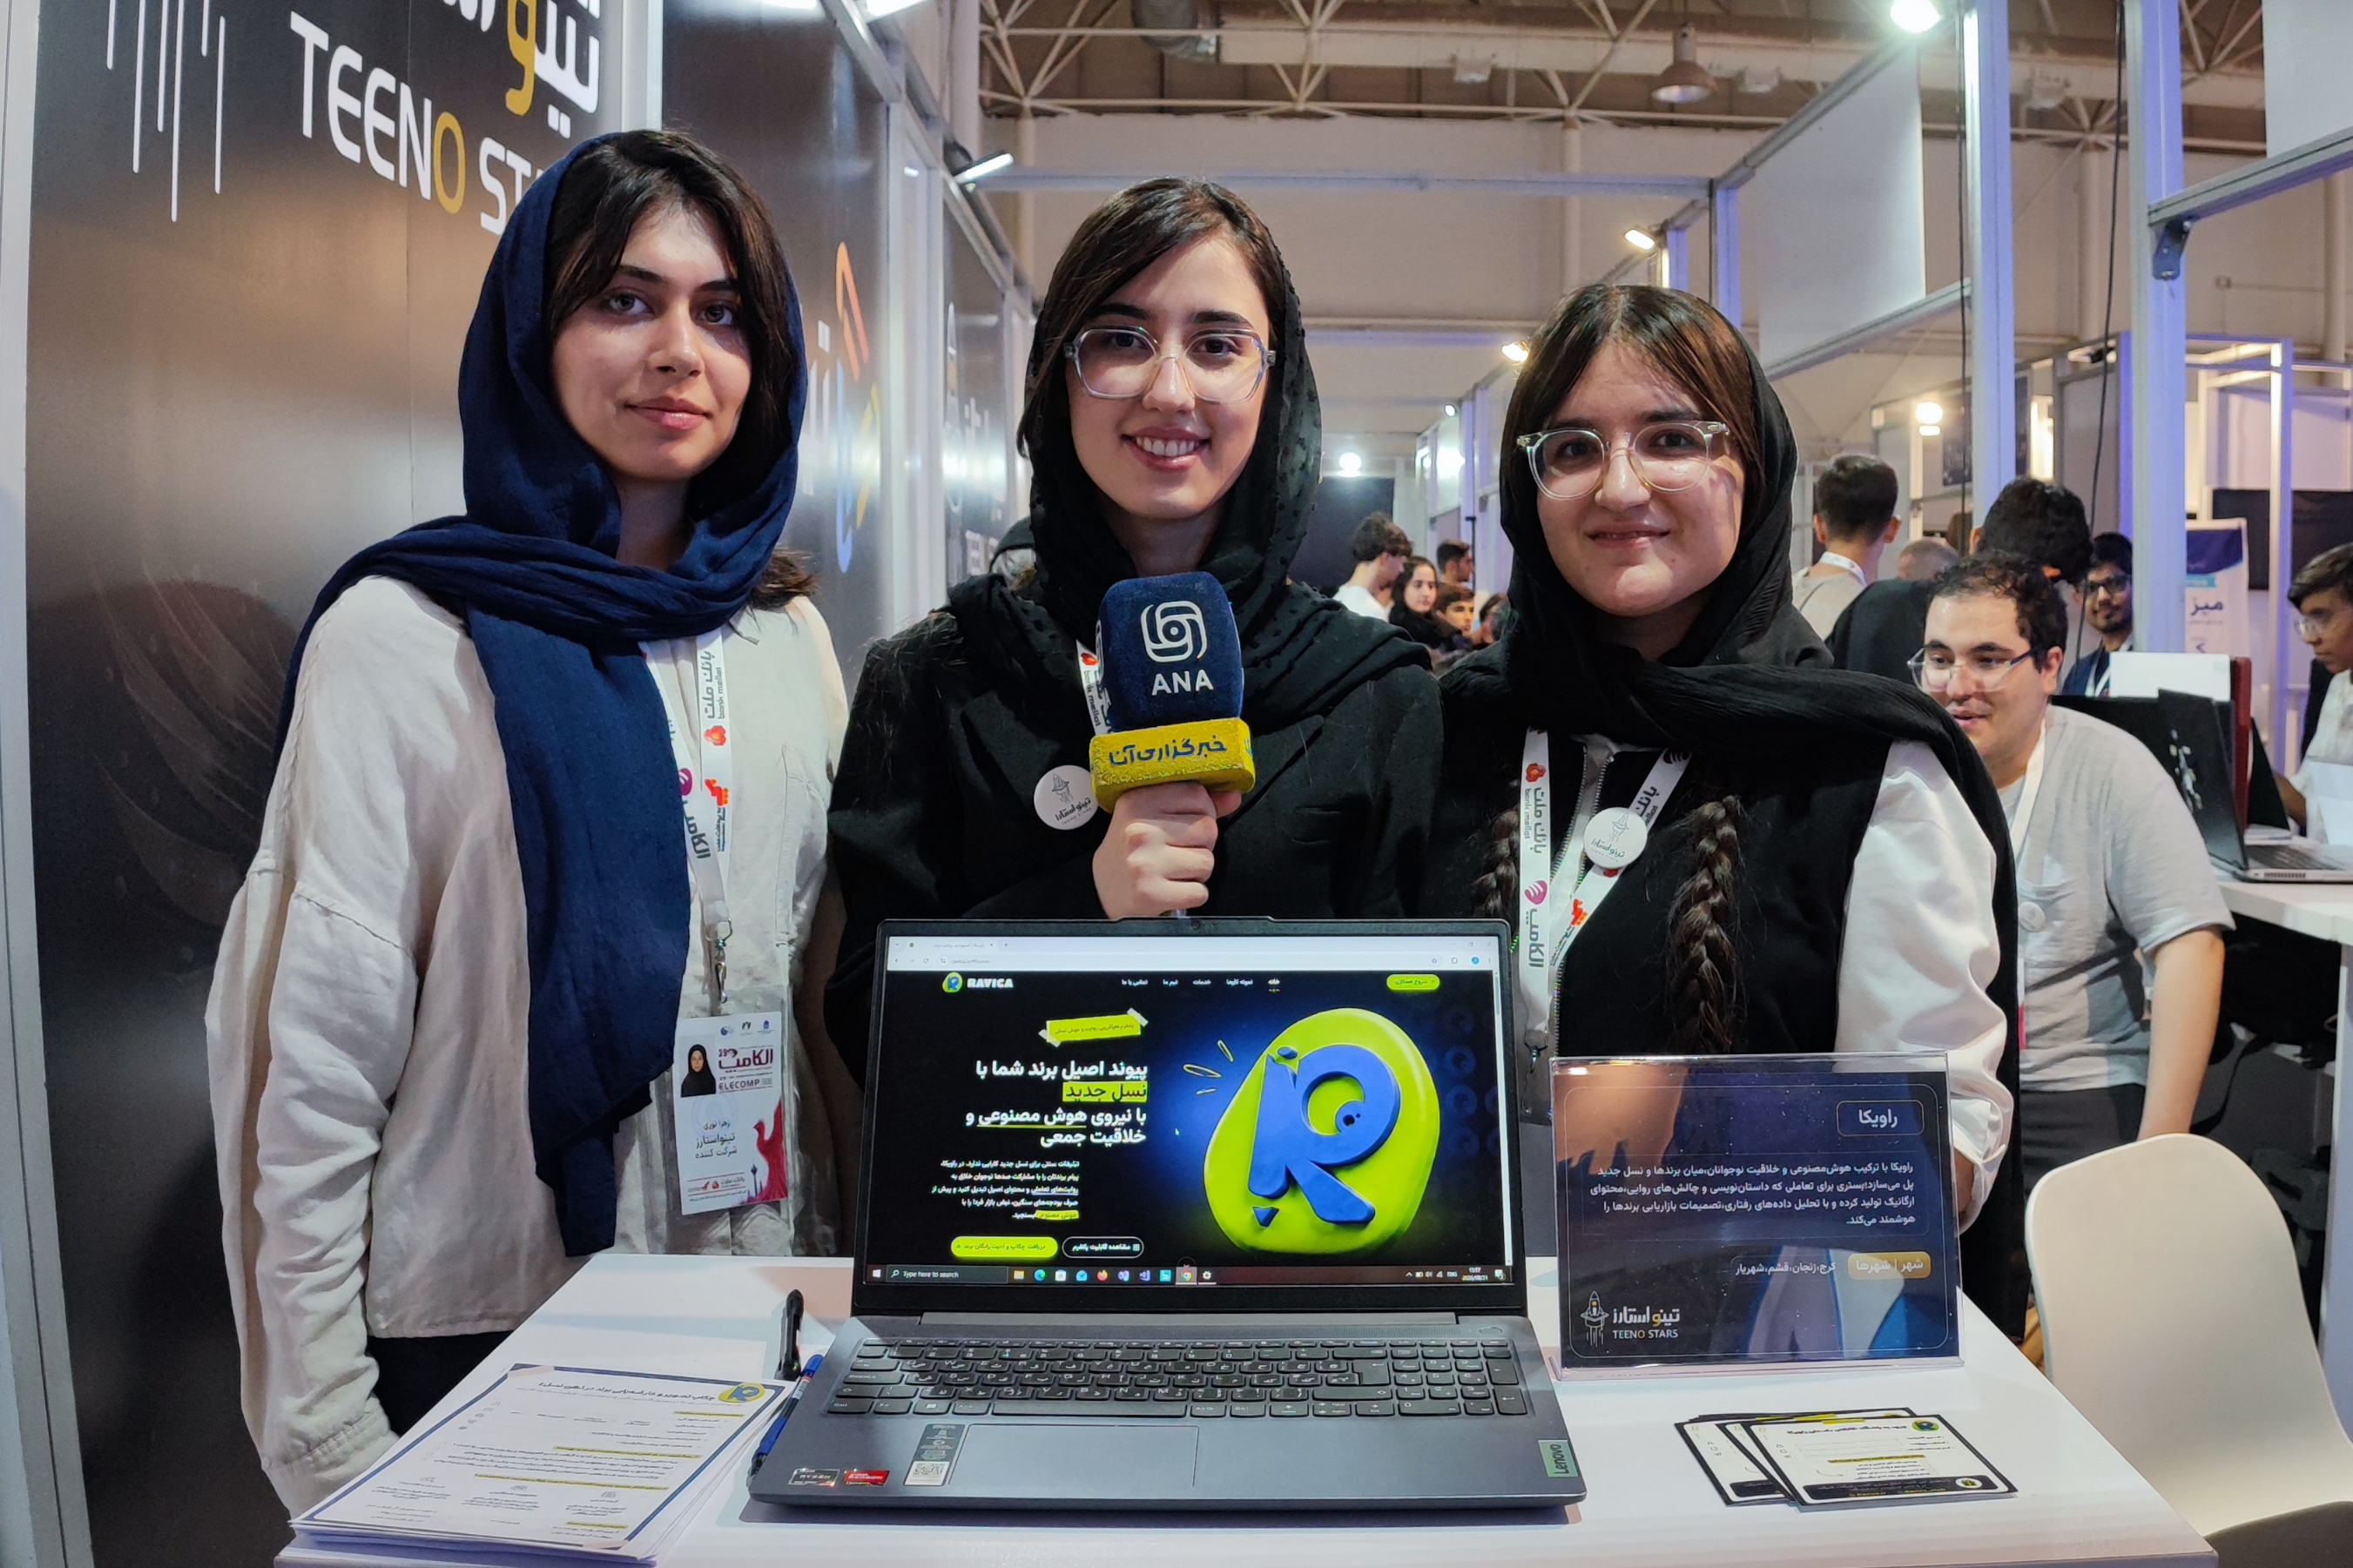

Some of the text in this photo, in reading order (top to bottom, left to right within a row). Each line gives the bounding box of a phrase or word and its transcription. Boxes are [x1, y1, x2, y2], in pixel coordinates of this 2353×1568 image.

[291, 10, 466, 214] TEENO
[1151, 669, 1214, 697] ANA
[1088, 694, 1101, 727] mellat
[1137, 734, 1228, 763] خبرگزاری
[967, 978, 1015, 988] RAVICA
[975, 1059, 1149, 1080] پیوند اصیل برند شما با
[718, 1078, 760, 1091] ELECOMP
[1066, 1083, 1148, 1103] نسل جدید
[965, 1107, 1147, 1127] با نیروی هوش مصنوعی و
[1858, 1108, 1898, 1128] راویکا
[1040, 1127, 1147, 1148] خلاقیت جمعی
[1597, 1167, 1621, 1177] جدید
[1623, 1166, 1643, 1177] نسل
[1654, 1165, 1681, 1177] برندها
[1746, 1164, 1780, 1176] خلاقیت
[1853, 1162, 1879, 1174] ترکیب
[1881, 1162, 1888, 1174] با
[1890, 1161, 1913, 1174] راویکا
[1771, 1181, 1783, 1190] که
[1785, 1181, 1814, 1194] تعاملی
[1817, 1180, 1834, 1193] برای
[1903, 1179, 1914, 1192] پل
[1603, 1201, 1610, 1214] را
[1612, 1201, 1640, 1214] برندها
[1642, 1200, 1677, 1213] بازاریابی
[1794, 1198, 1821, 1211] تحلیل
[1822, 1198, 1830, 1210] با
[1838, 1197, 1858, 1209] کرده
[1860, 1196, 1882, 1209] تولید
[1884, 1195, 1915, 1208] ارگانیک
[1878, 1215, 1916, 1226] هوشمند
[1856, 1257, 1924, 1274] شهر شهرها
[902, 1270, 917, 1279] Type
[940, 1270, 960, 1279] search
[1612, 1329, 1679, 1340] TEENO STARS
[1550, 1444, 1570, 1474] Lenovo
